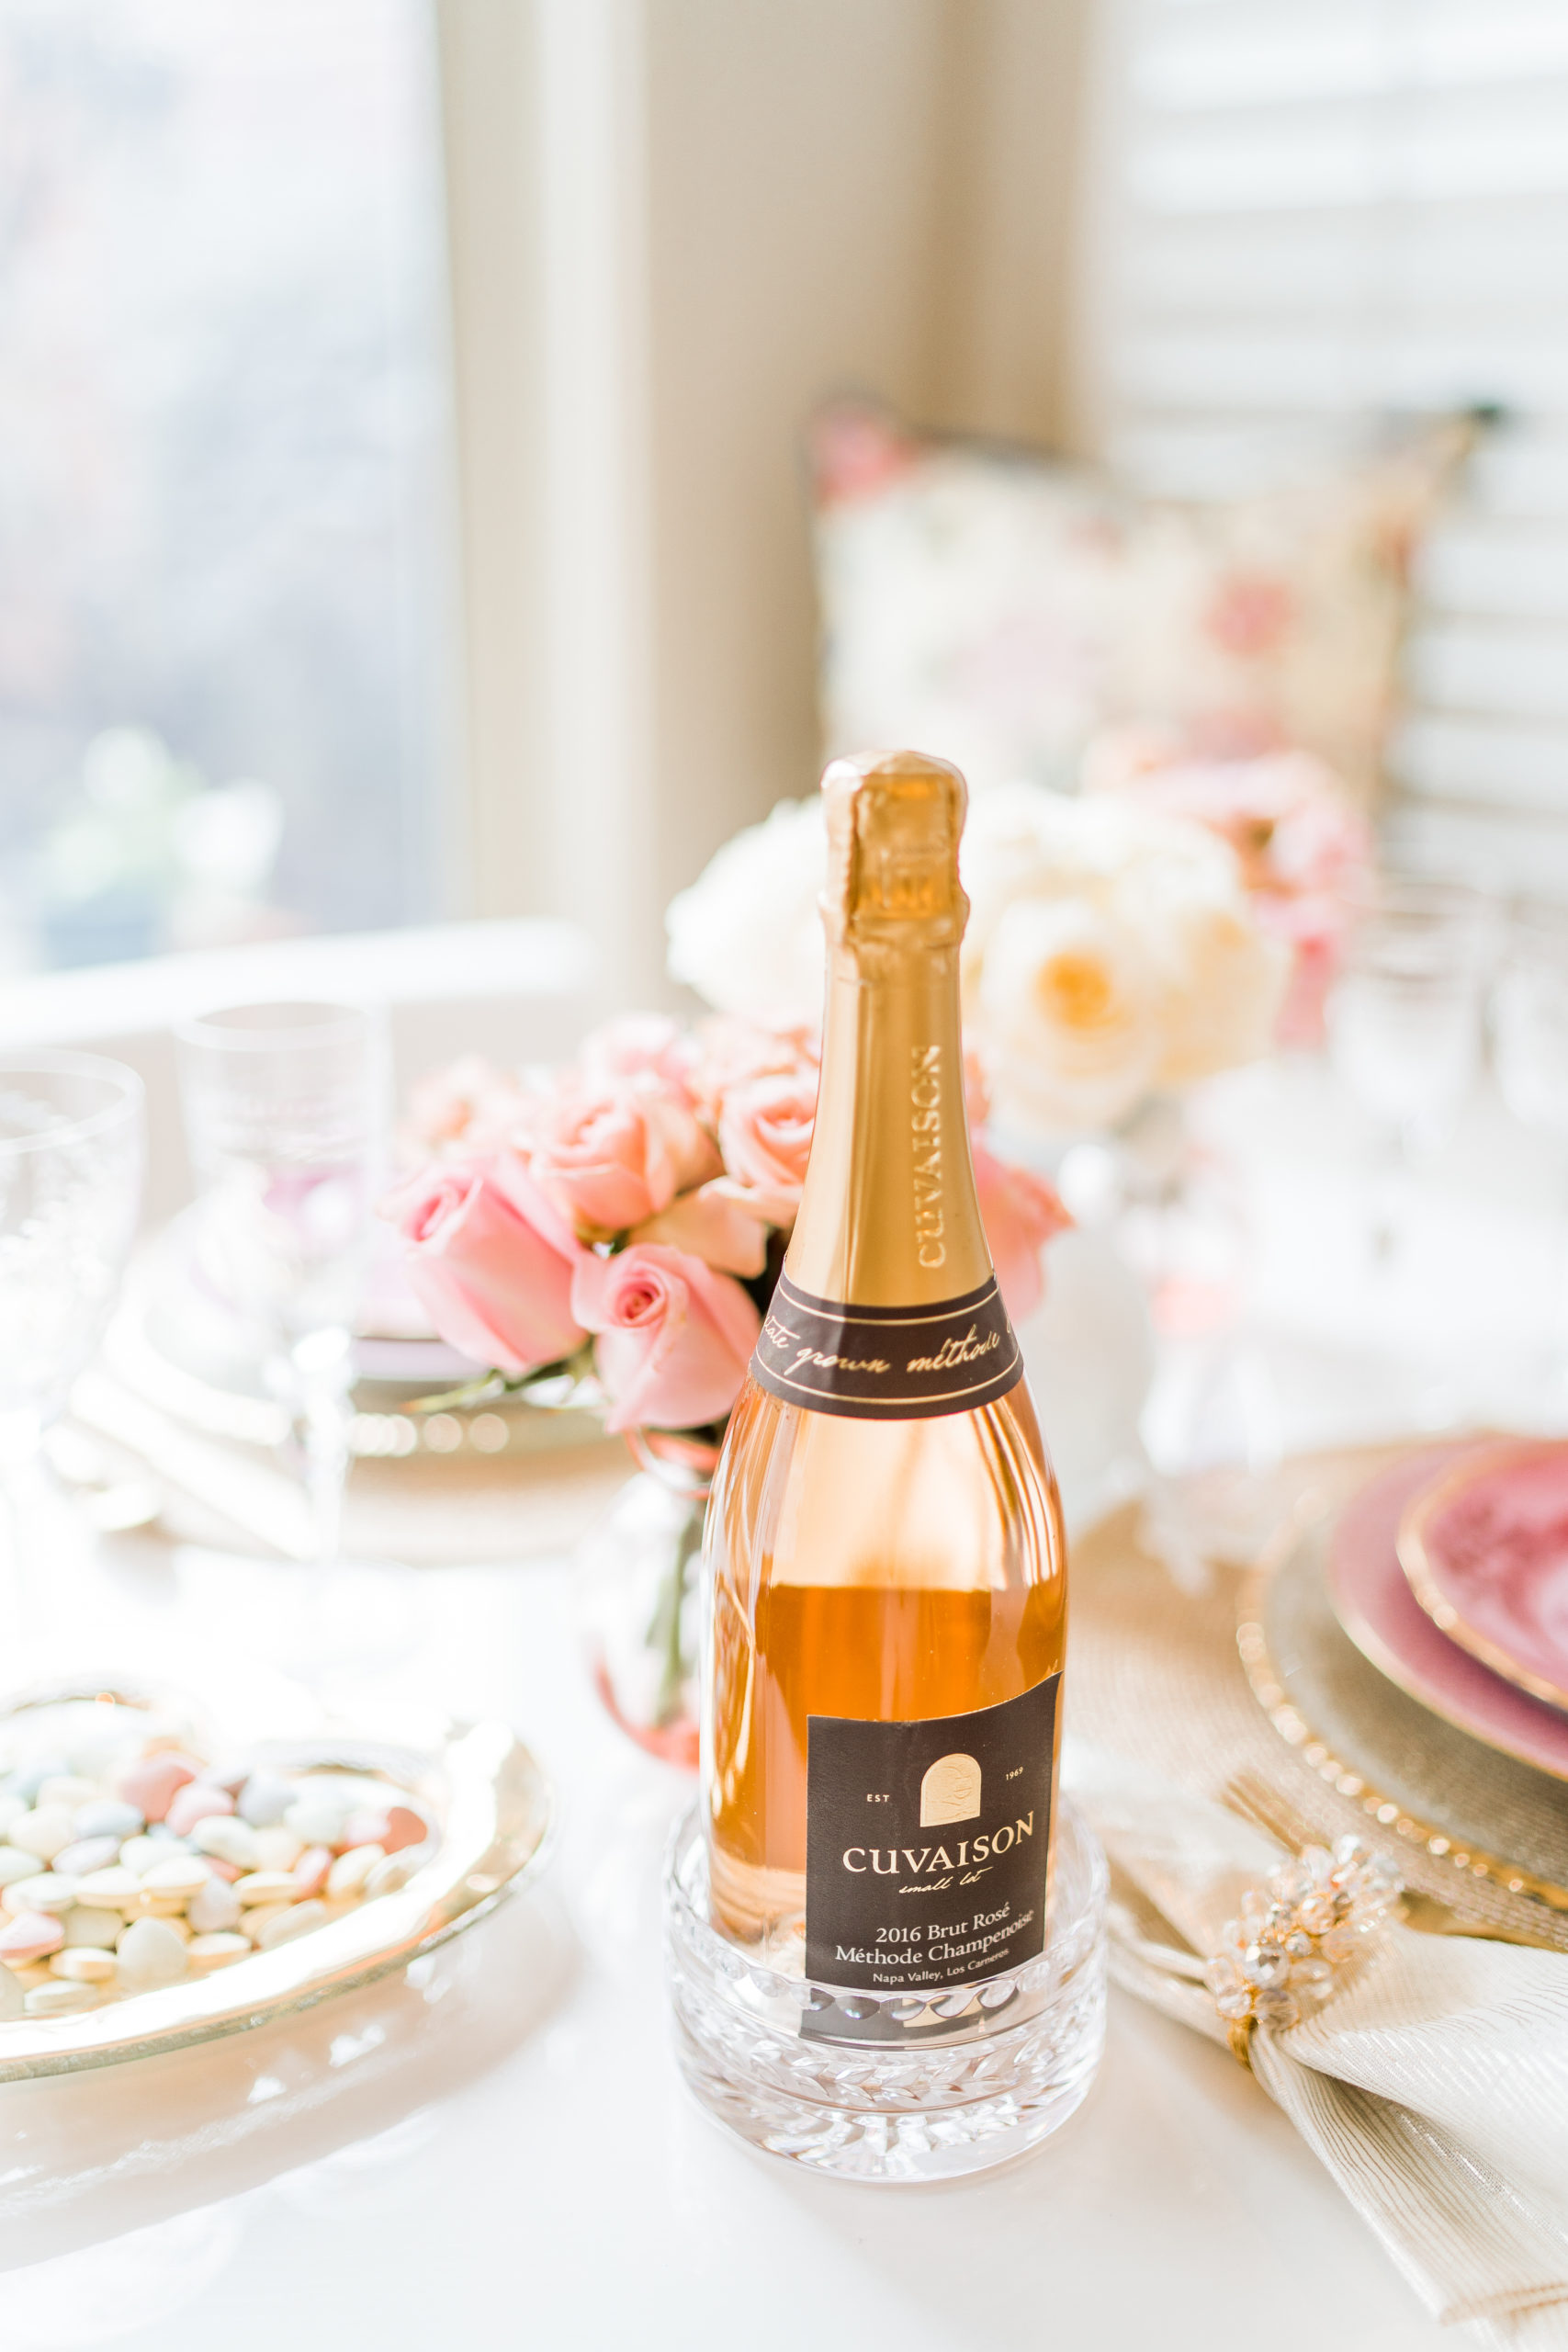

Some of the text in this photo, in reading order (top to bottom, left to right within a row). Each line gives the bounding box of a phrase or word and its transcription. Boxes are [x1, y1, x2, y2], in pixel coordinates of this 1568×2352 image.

[911, 1045, 946, 1269] CUVAISON
[784, 1346, 892, 1376] grown
[907, 1324, 999, 1373] méthode
[866, 1766, 1024, 1803] EST 1969
[842, 1810, 1034, 1875] CUVAISON
[898, 1866, 994, 1895] small lot
[835, 1910, 1034, 1965] Méthode Champenoise
[875, 1901, 1010, 1944] 2016 Brut Rosé
[874, 1948, 1010, 1985] Napa Valley, Los Carneros
